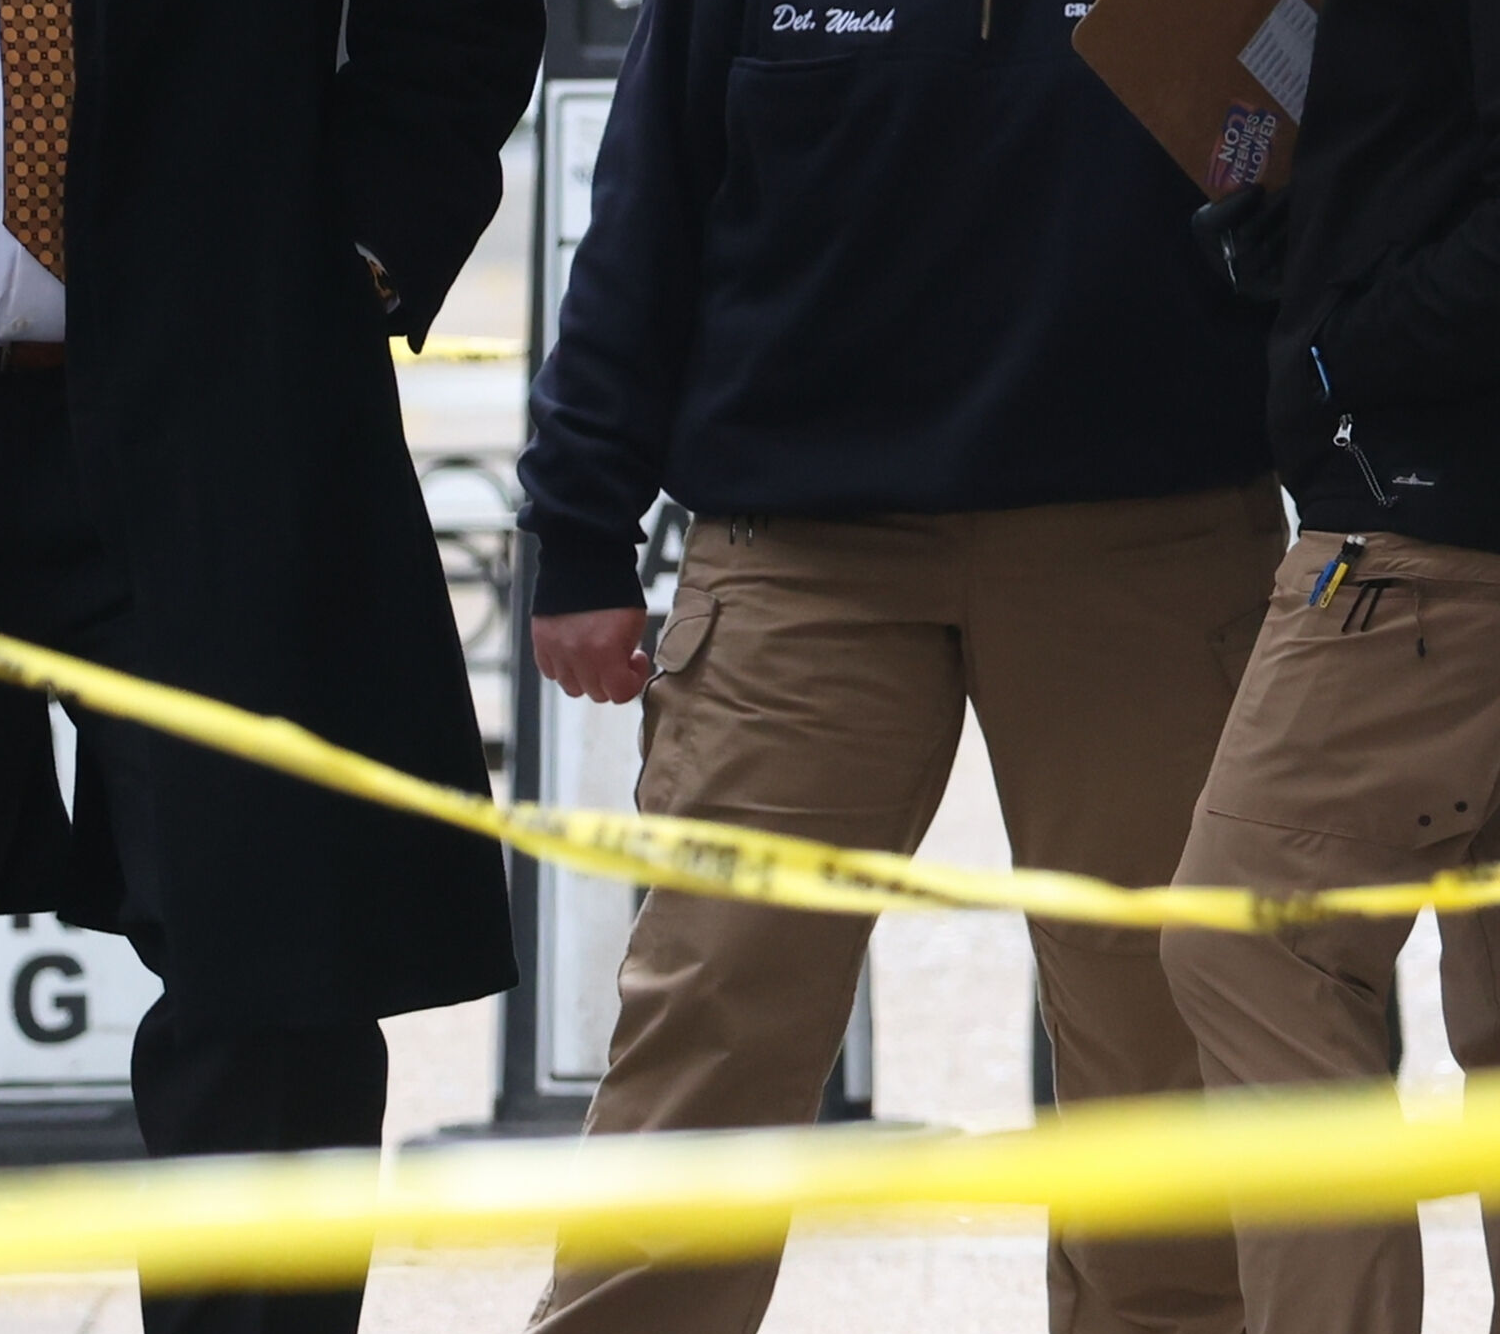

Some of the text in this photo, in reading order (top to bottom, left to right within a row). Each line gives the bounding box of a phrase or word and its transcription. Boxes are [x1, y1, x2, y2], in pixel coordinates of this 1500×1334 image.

[772, 3, 895, 34] Det. Walsh
[1218, 127, 1240, 163] NO
